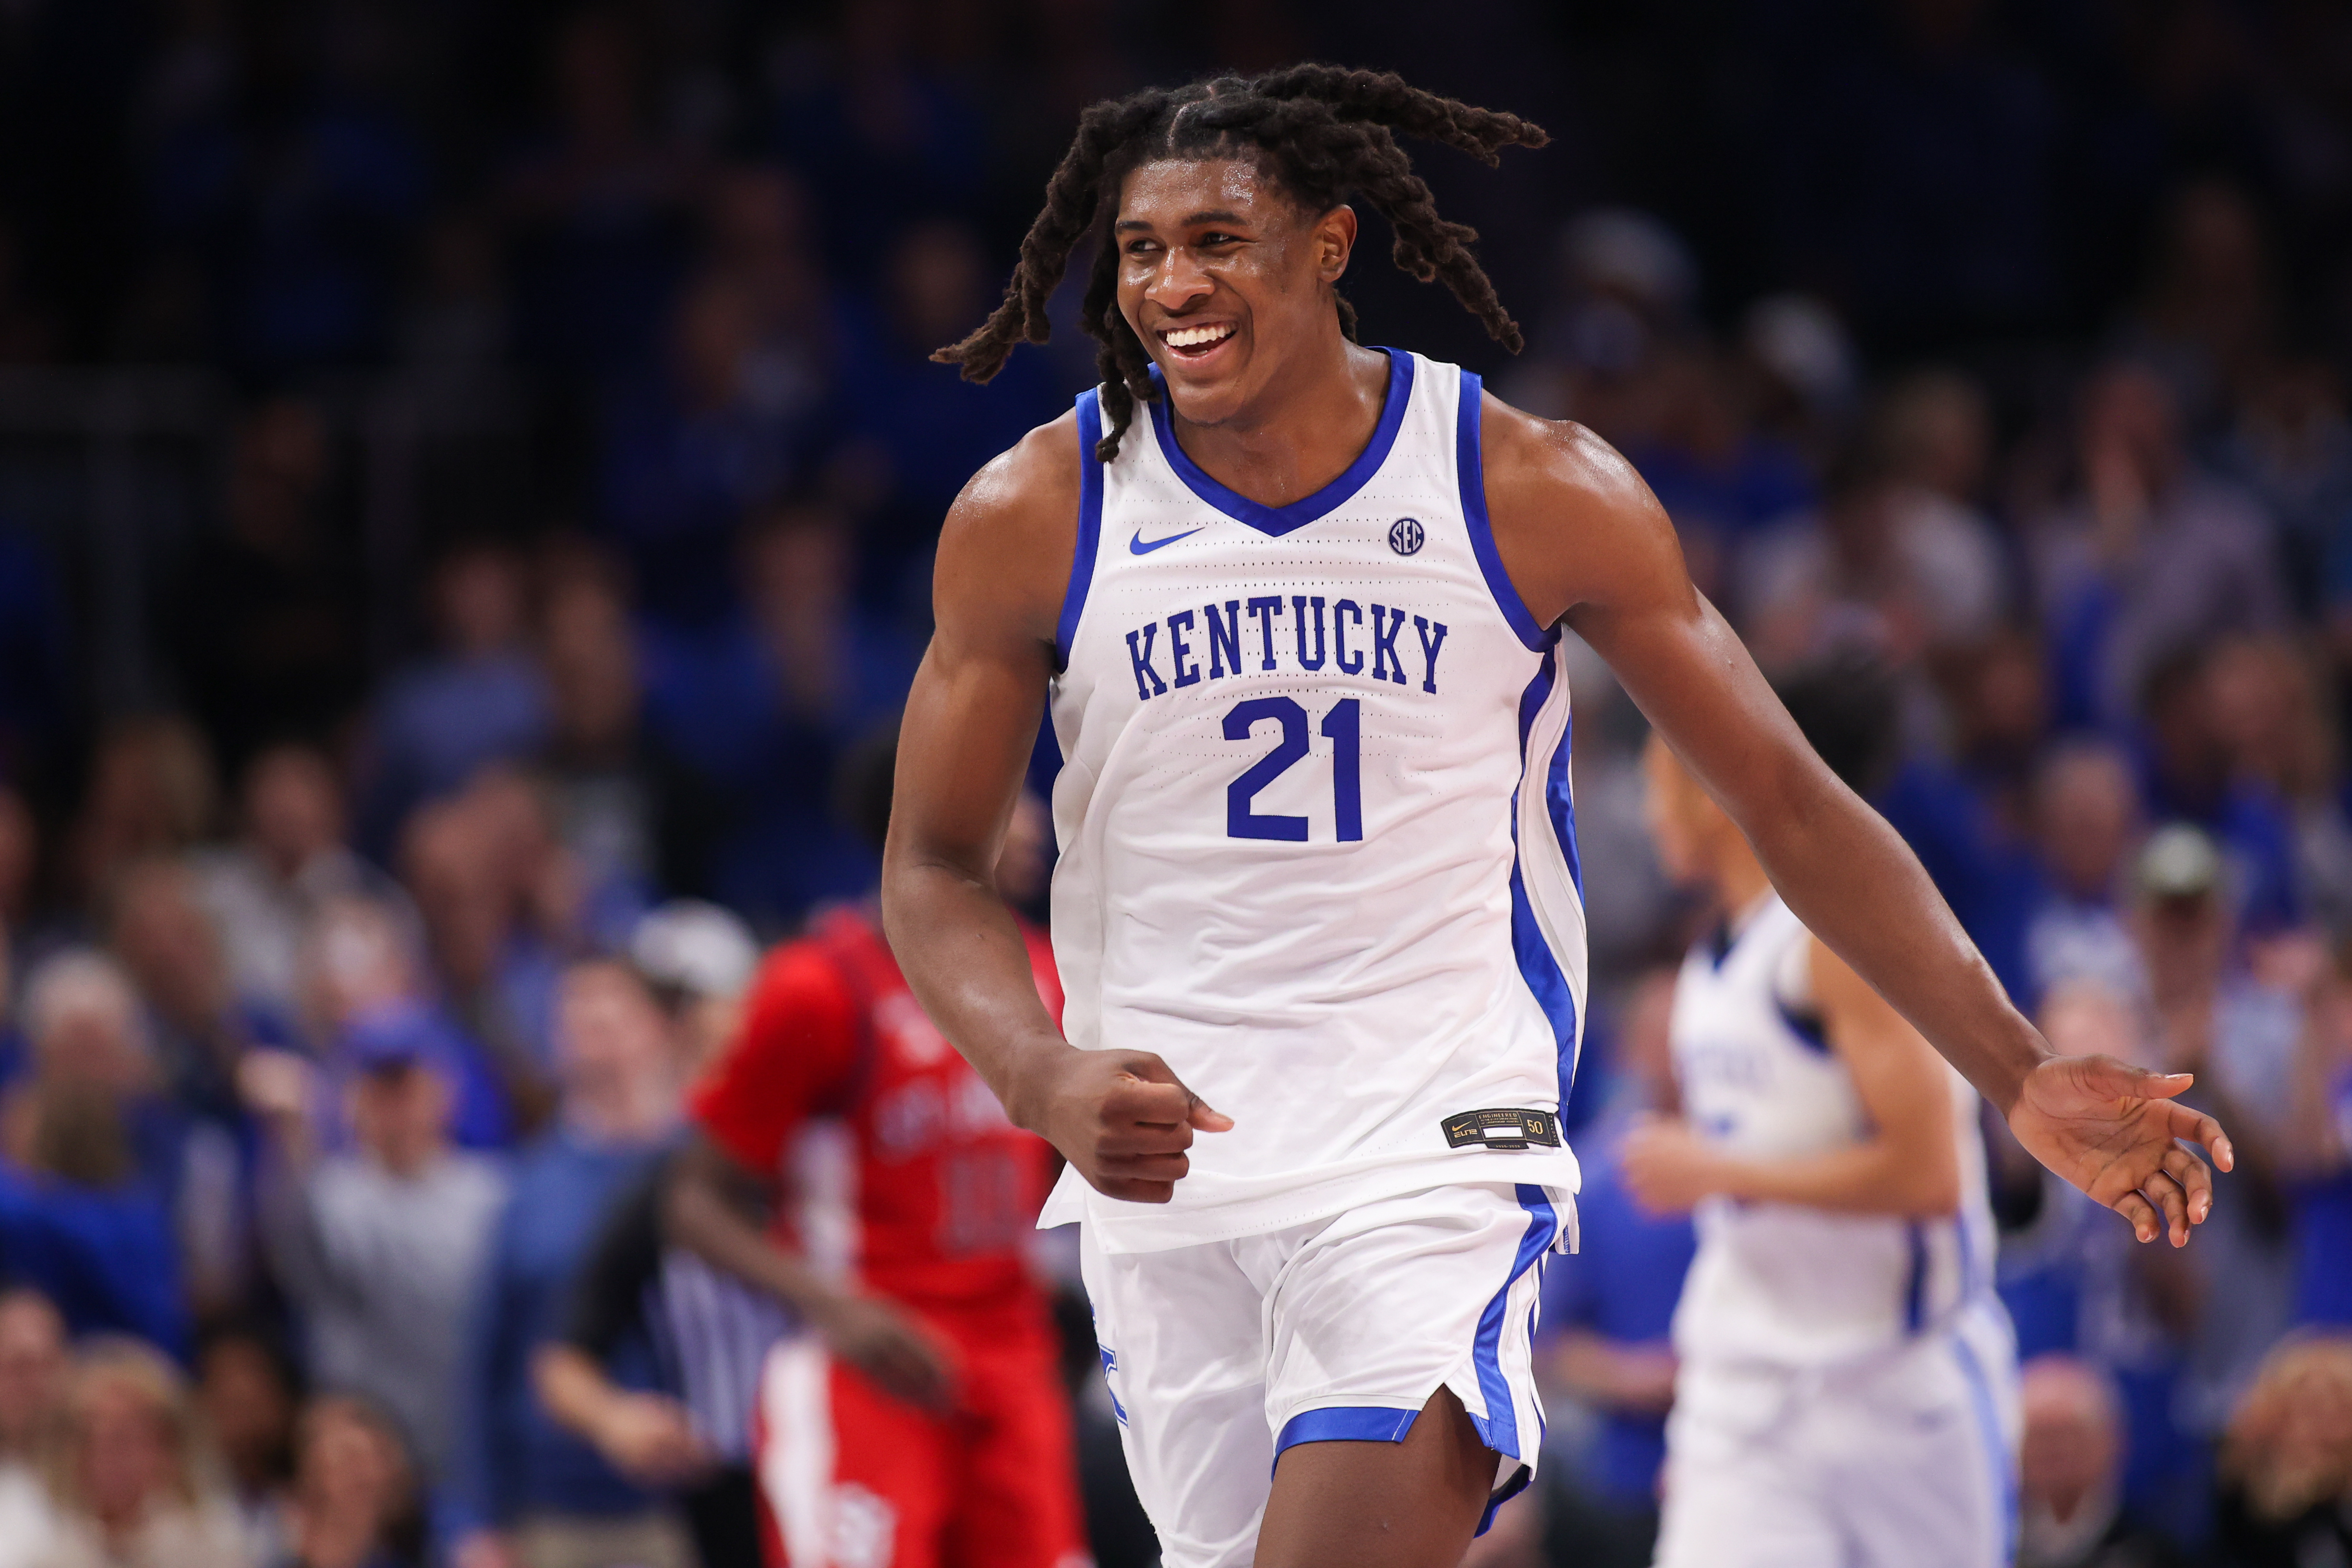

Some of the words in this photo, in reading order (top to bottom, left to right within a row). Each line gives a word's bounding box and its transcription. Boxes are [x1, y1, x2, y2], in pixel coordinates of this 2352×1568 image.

[1391, 520, 1422, 554] SEC
[1126, 595, 1447, 700] KENTUCKY
[1222, 696, 1363, 842] 21
[1453, 1129, 1478, 1138] ELITE
[1527, 1119, 1544, 1134] 50
